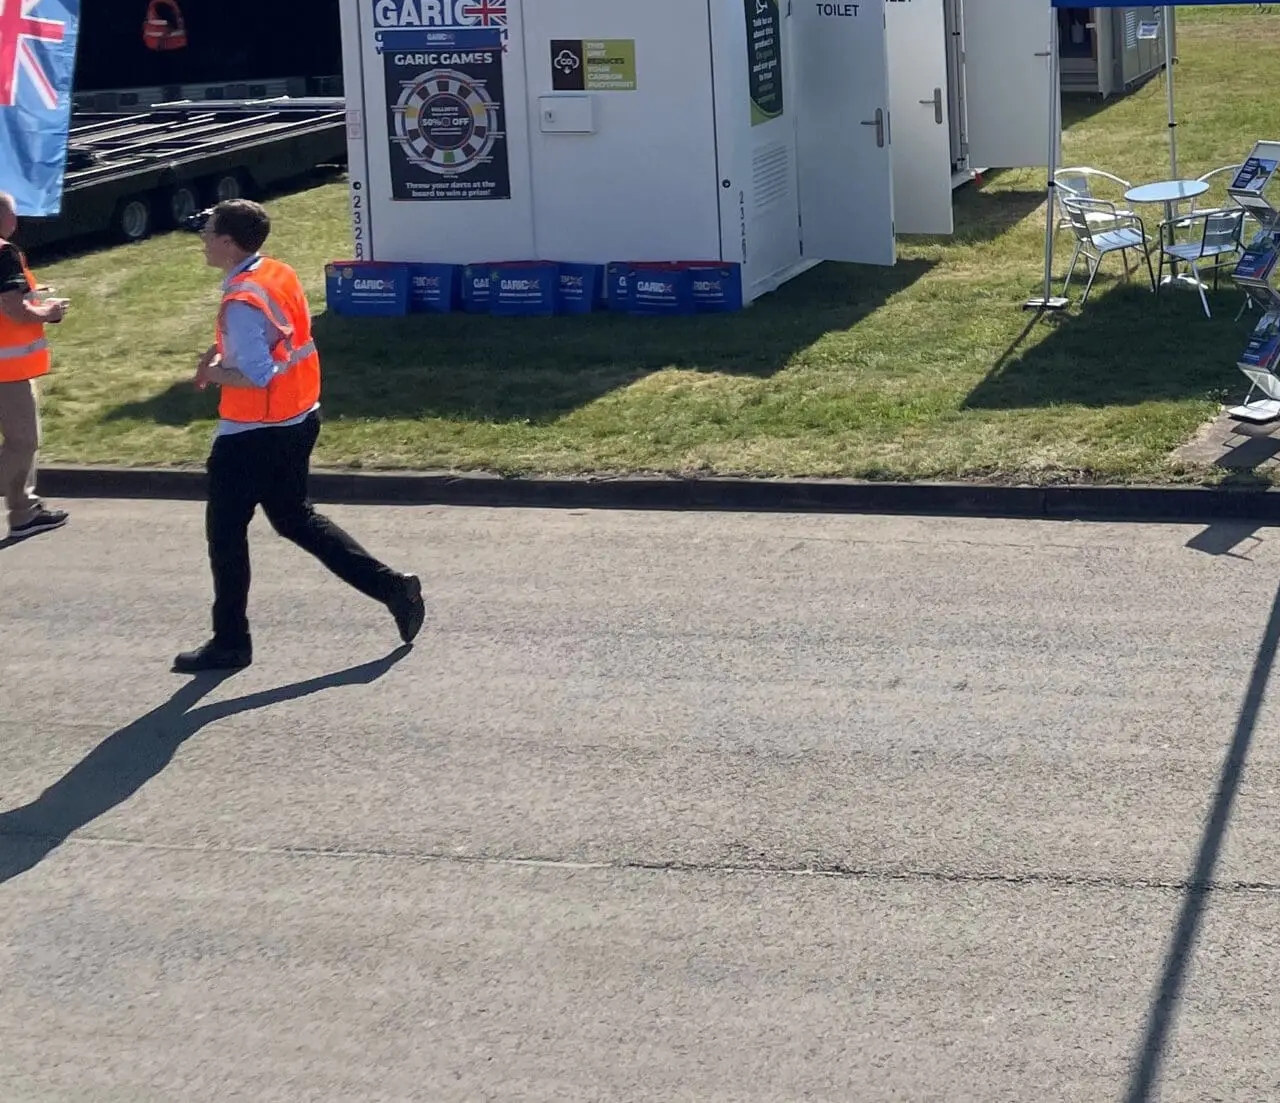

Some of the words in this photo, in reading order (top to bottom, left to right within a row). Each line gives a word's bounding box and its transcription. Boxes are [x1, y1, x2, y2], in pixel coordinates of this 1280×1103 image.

[816, 3, 860, 17] TOILET
[394, 54, 438, 65] GARIC
[440, 53, 493, 65] GAMES
[422, 118, 442, 126] 50%
[452, 117, 470, 126] OFF
[354, 279, 384, 290] GARIC
